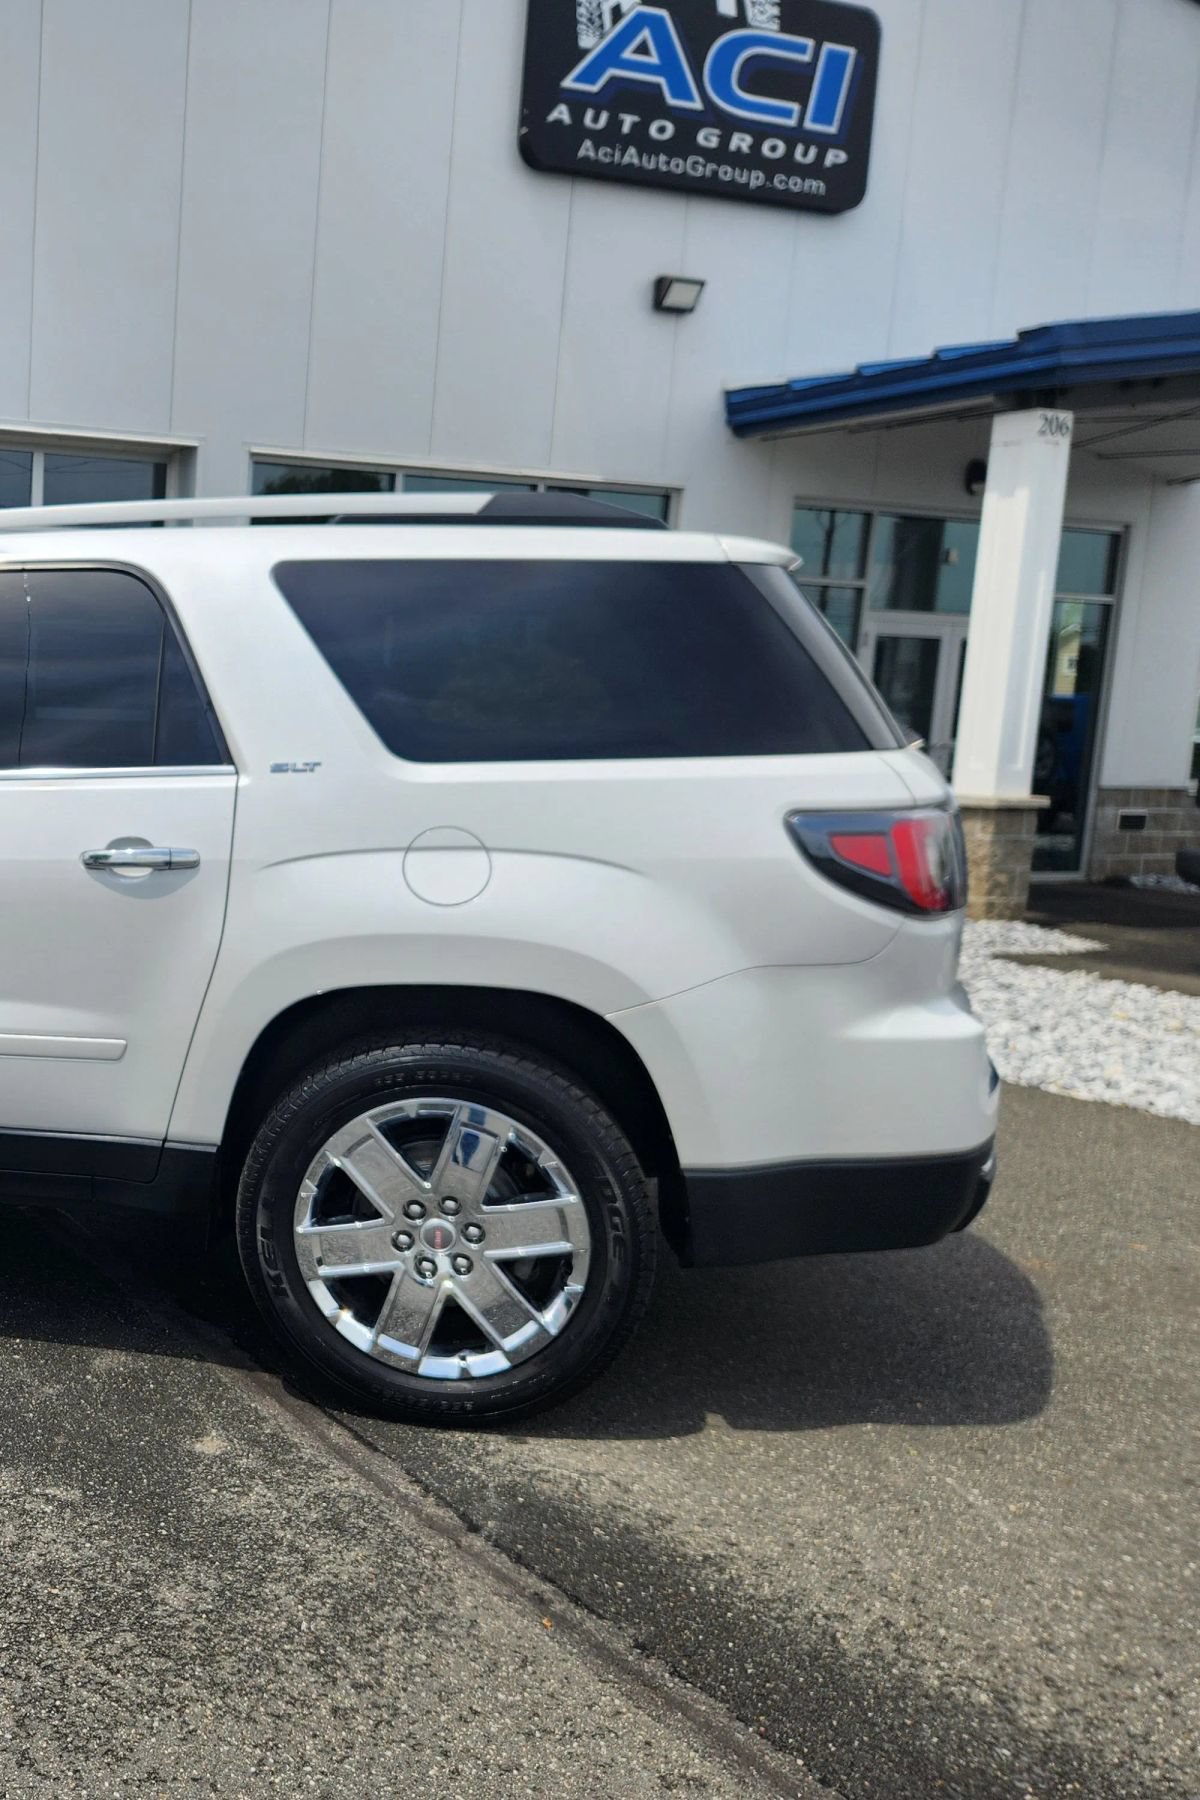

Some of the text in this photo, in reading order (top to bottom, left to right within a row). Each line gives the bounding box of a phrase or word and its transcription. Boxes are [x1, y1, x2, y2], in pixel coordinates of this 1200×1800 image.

[560, 4, 857, 135] ACI
[546, 103, 849, 168] AUTO GROUP
[577, 139, 827, 196] AciAutoGroup.com
[1036, 413, 1070, 437] 206
